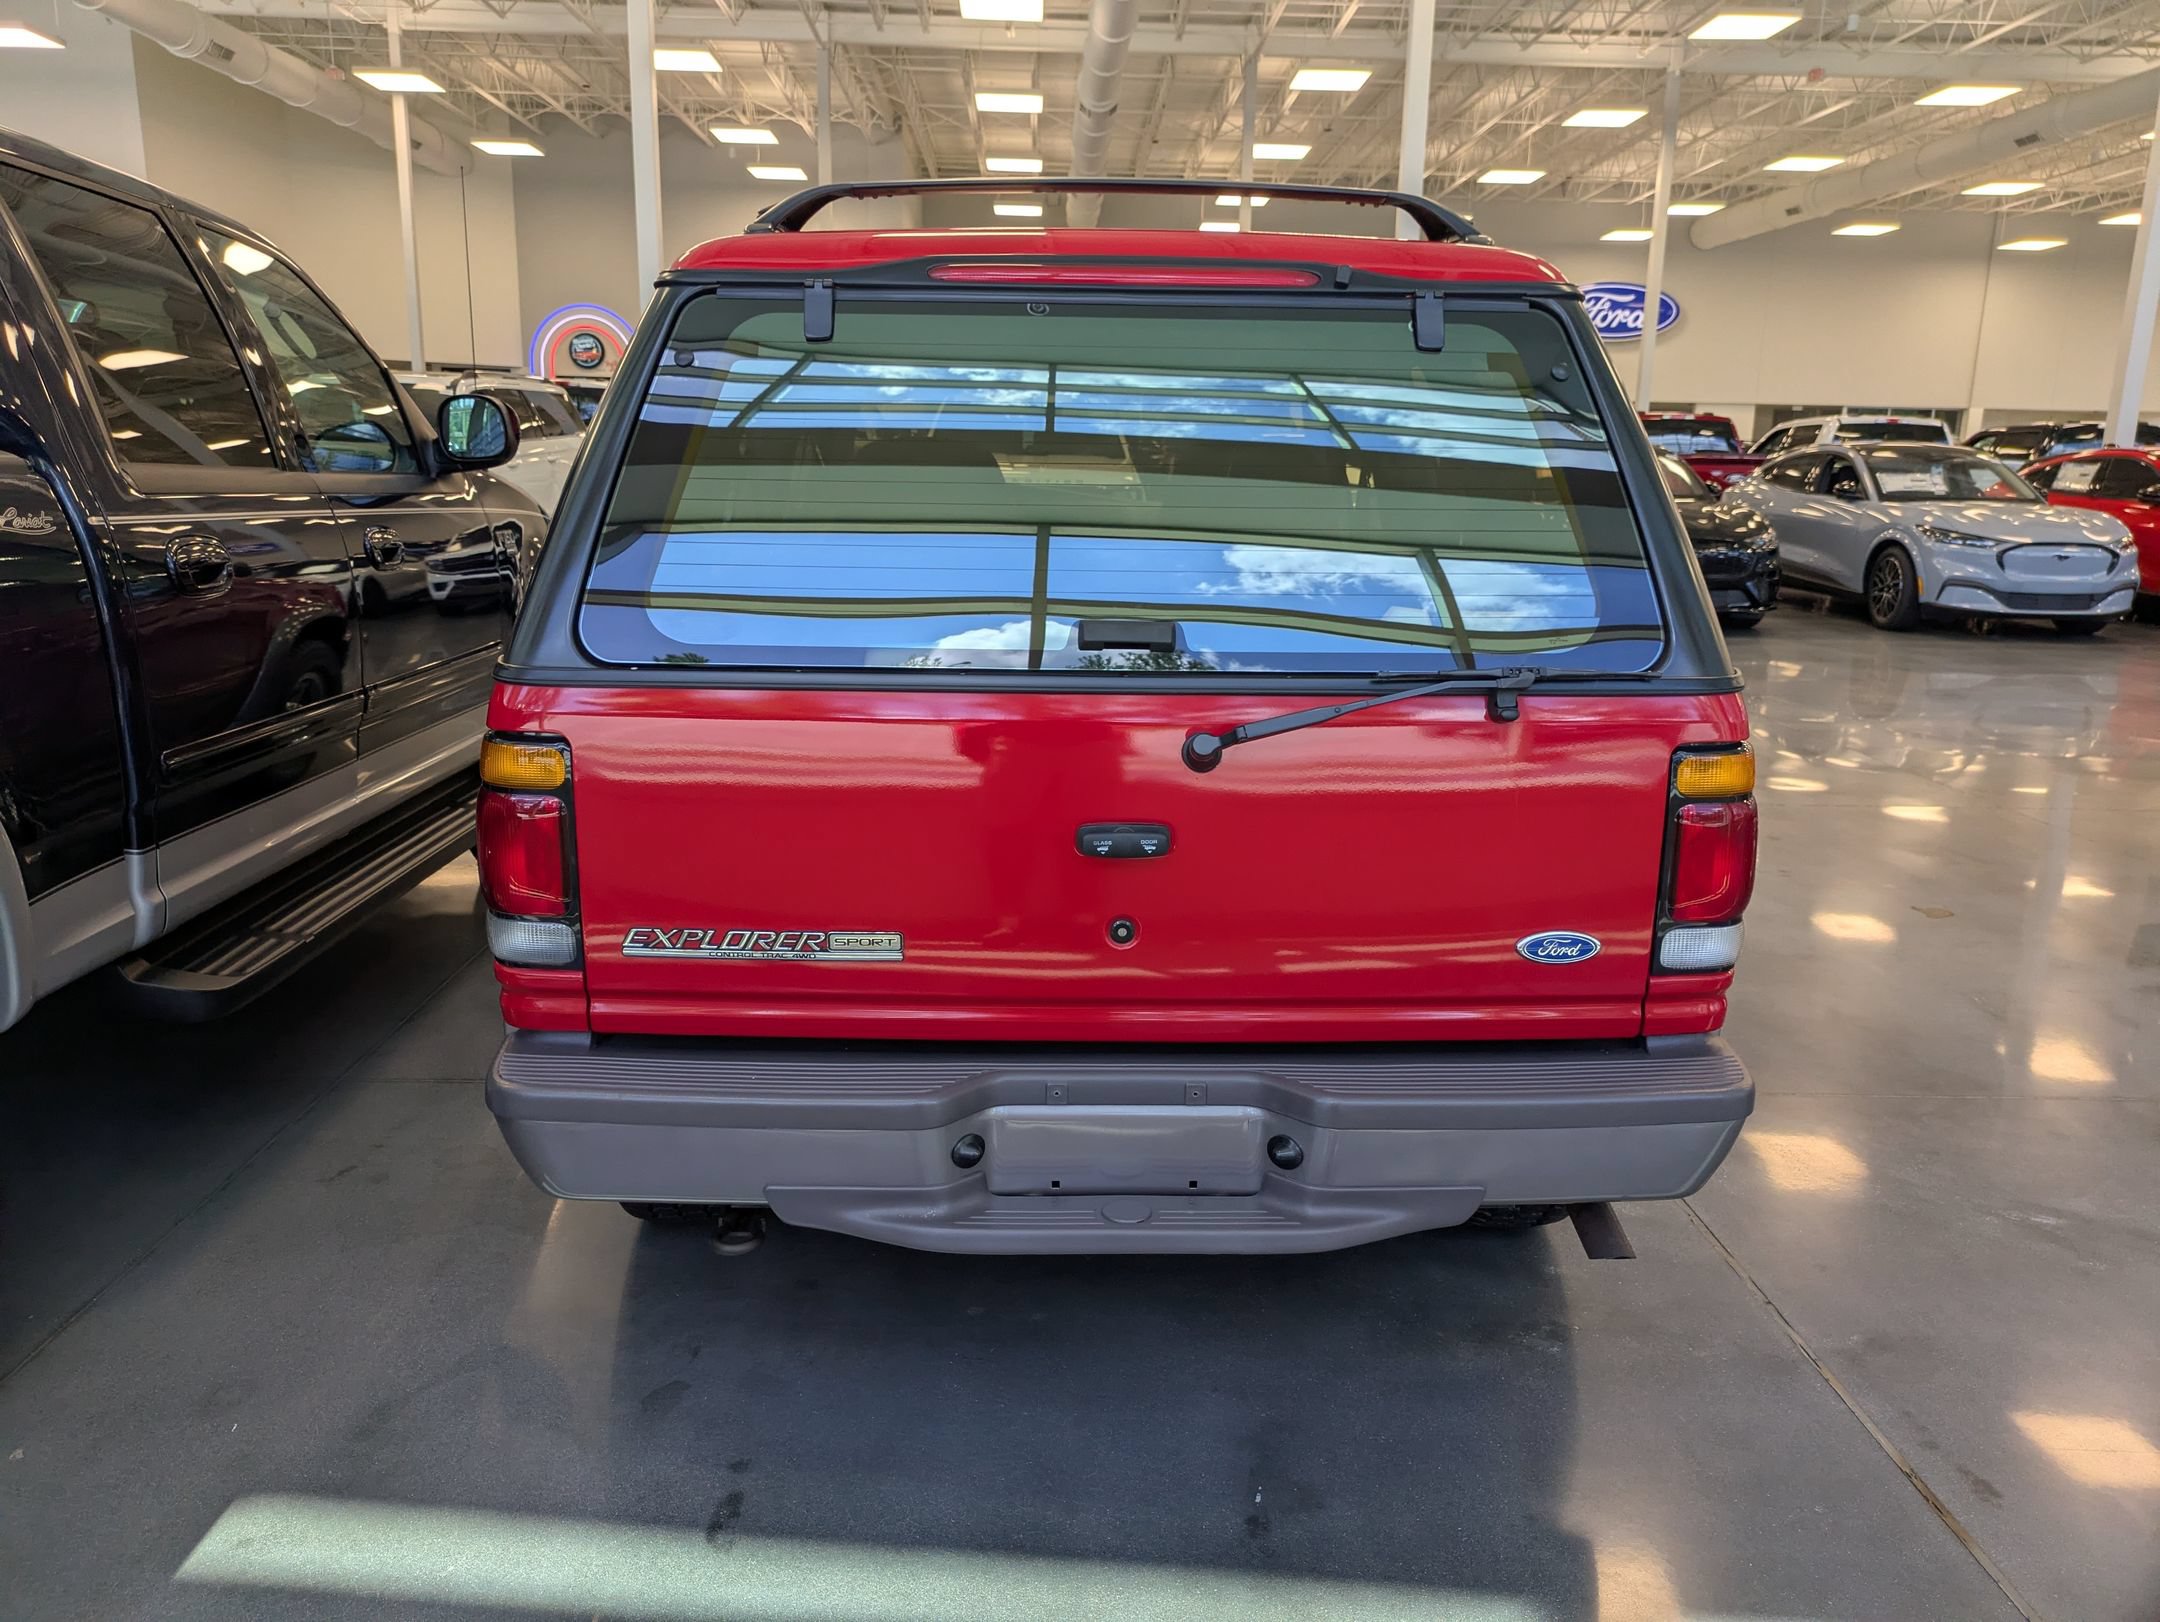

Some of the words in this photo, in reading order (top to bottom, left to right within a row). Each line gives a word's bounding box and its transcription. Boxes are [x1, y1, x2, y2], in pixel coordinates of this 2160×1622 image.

[622, 928, 826, 950] EXPLORER
[834, 938, 897, 947] SPORT
[1537, 938, 1582, 956] Ford
